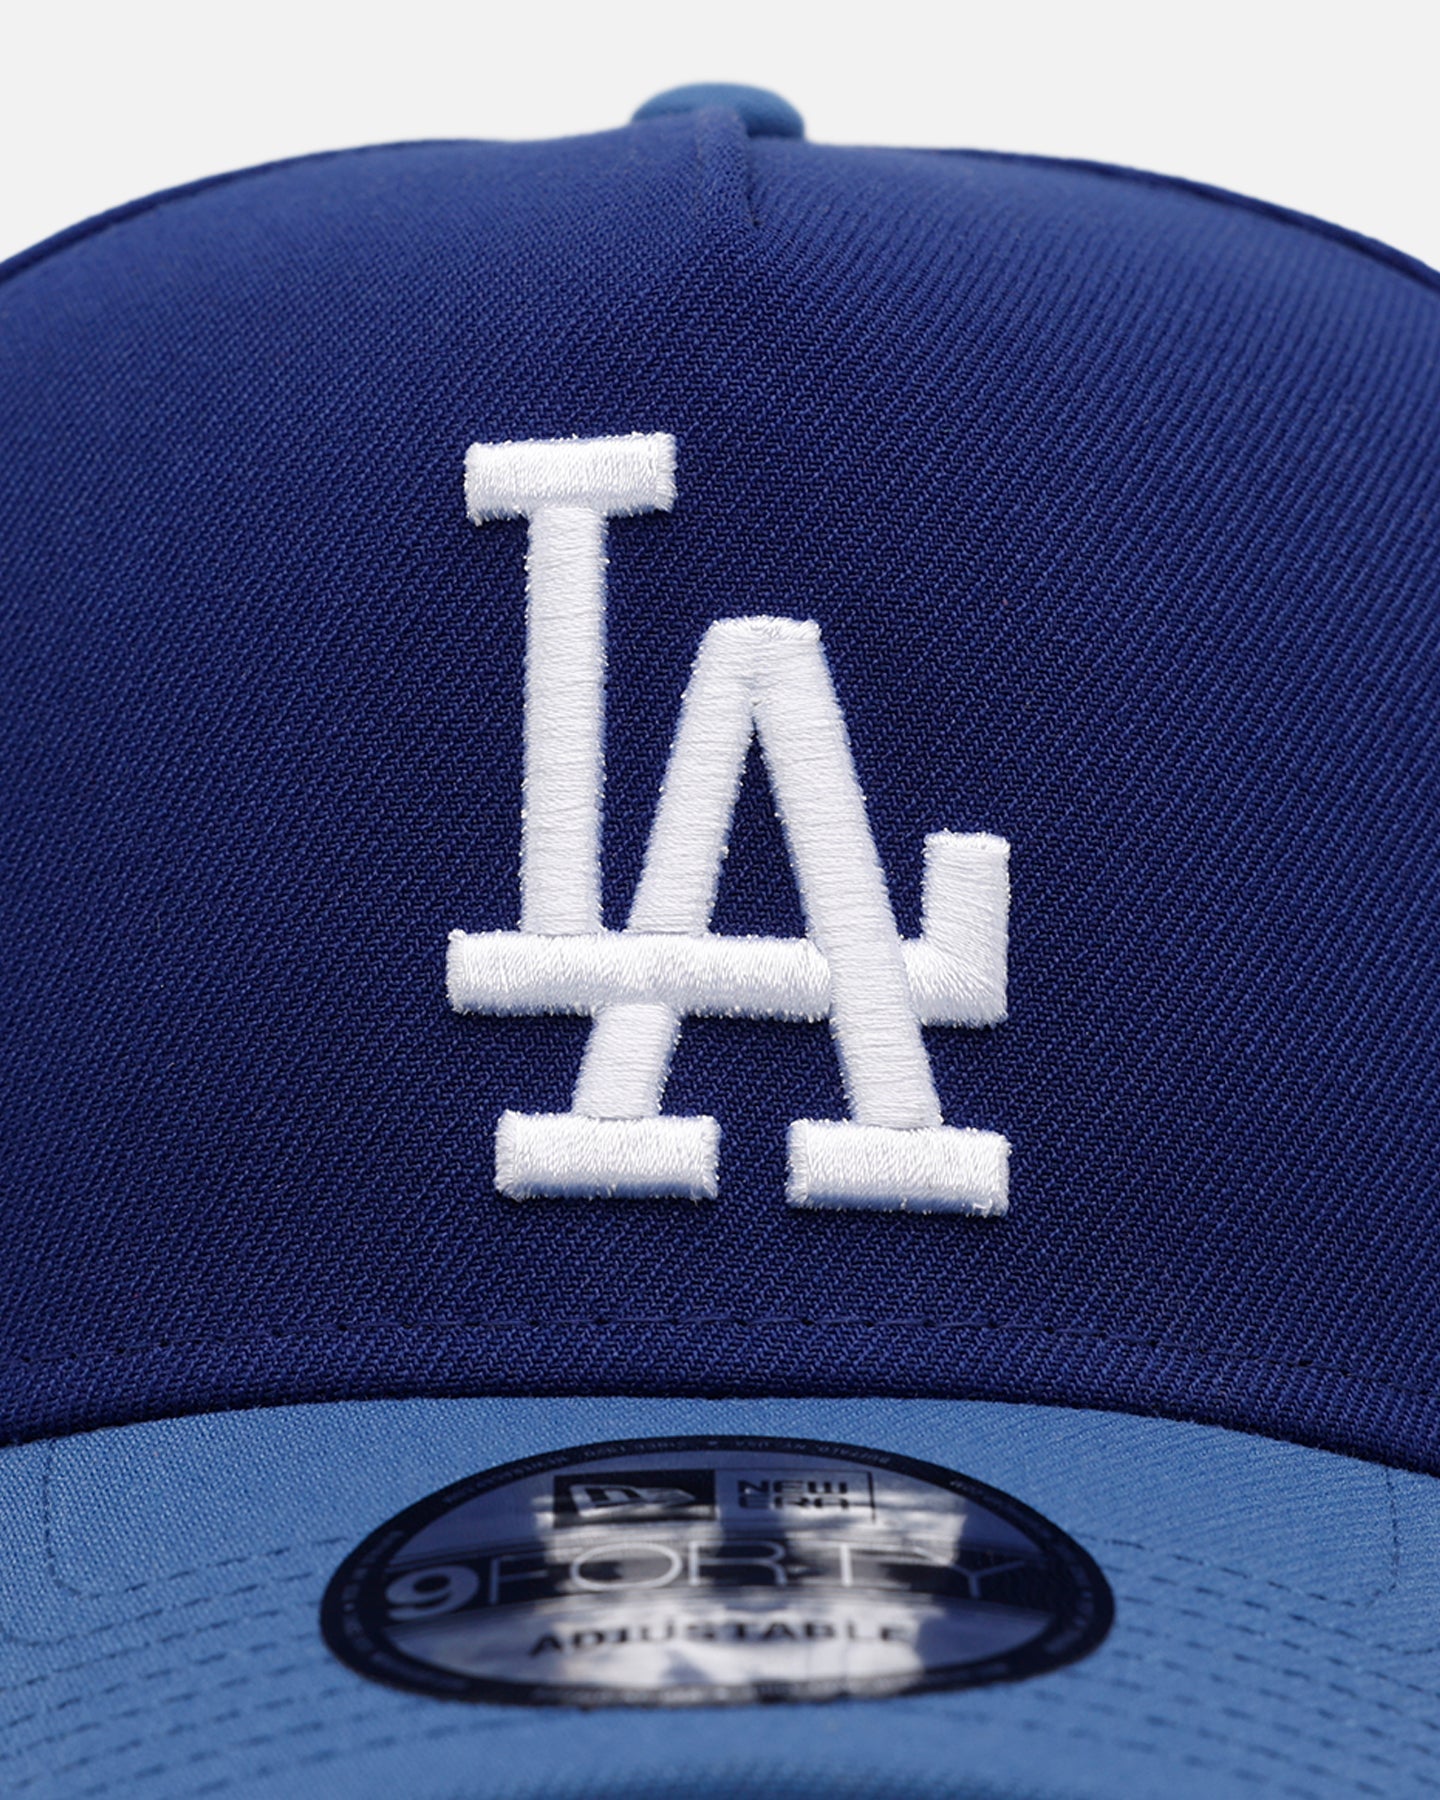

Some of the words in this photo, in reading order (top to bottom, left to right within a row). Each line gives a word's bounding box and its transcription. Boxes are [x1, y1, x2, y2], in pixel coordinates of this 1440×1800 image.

[447, 432, 1010, 1217] LA
[738, 1480, 848, 1494] NEW
[738, 1496, 849, 1509] ERA
[530, 1621, 907, 1657] ADJUSTABLE
